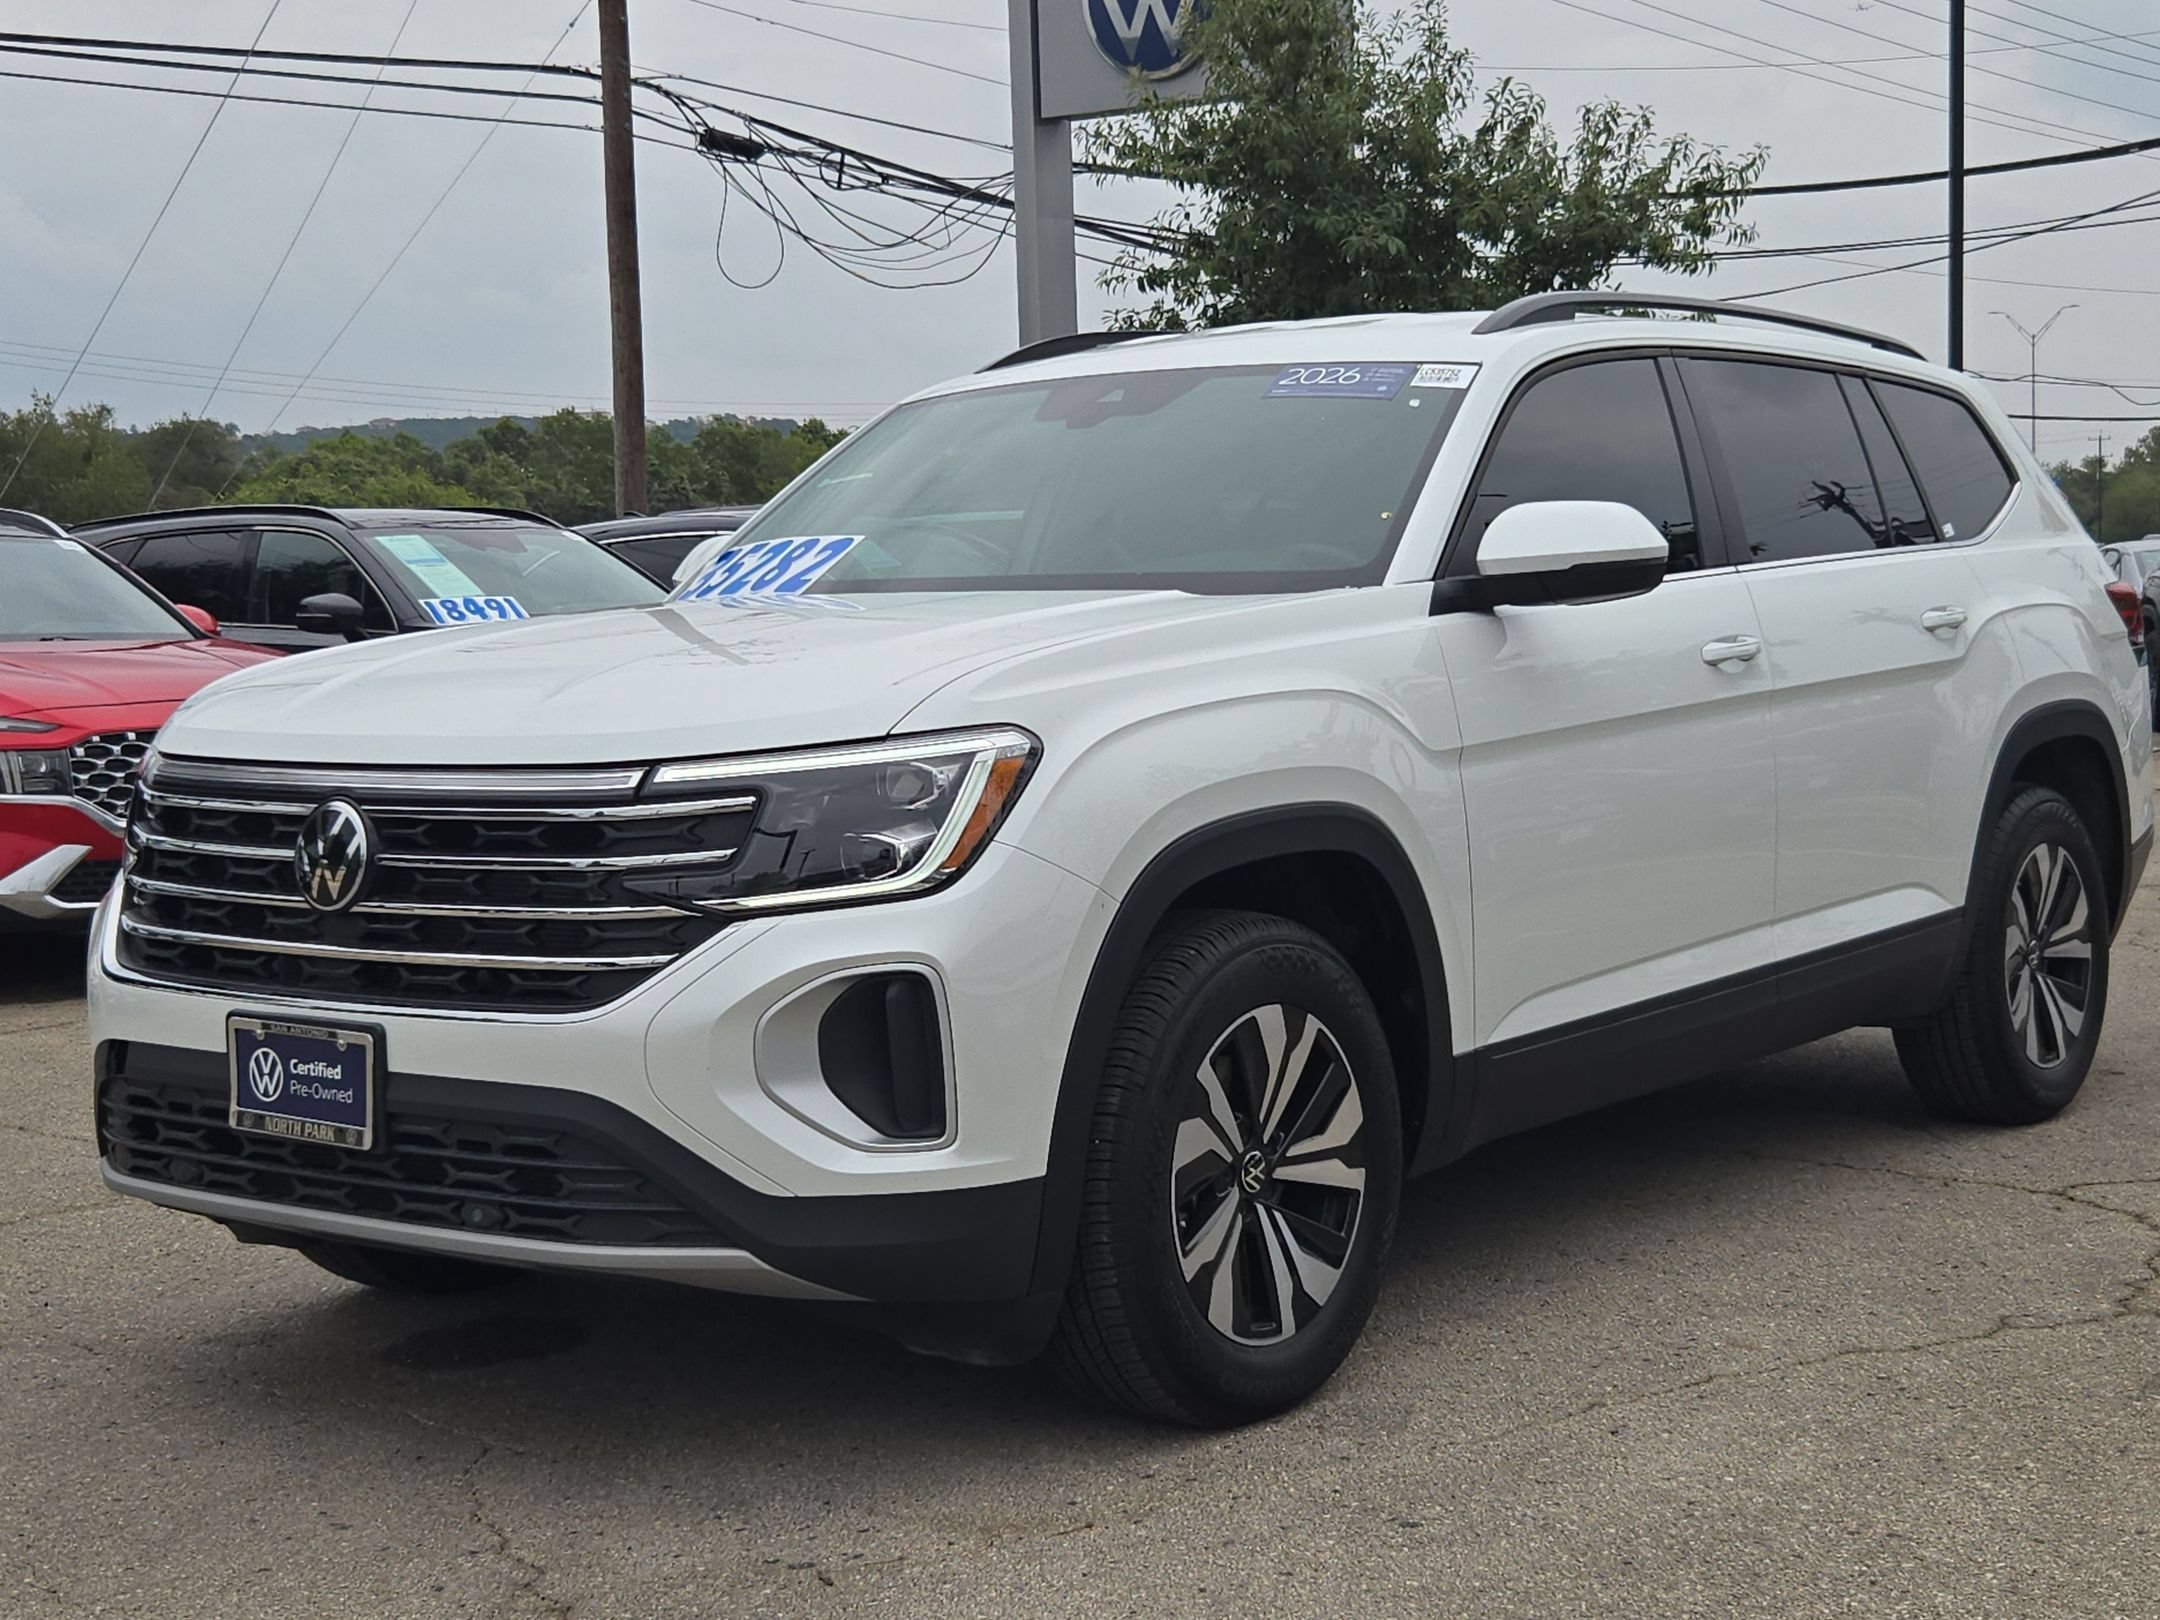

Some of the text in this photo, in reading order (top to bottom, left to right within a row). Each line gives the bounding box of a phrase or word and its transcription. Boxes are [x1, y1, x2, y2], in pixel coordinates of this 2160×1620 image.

[1279, 367, 1361, 385] 2026
[424, 596, 525, 624] 18491
[271, 1024, 329, 1039] SAN ANTONIO
[290, 1059, 342, 1080] Certified
[290, 1080, 353, 1104] Pre-Owned
[264, 1116, 302, 1137] NORTH
[304, 1122, 335, 1142] PARK
